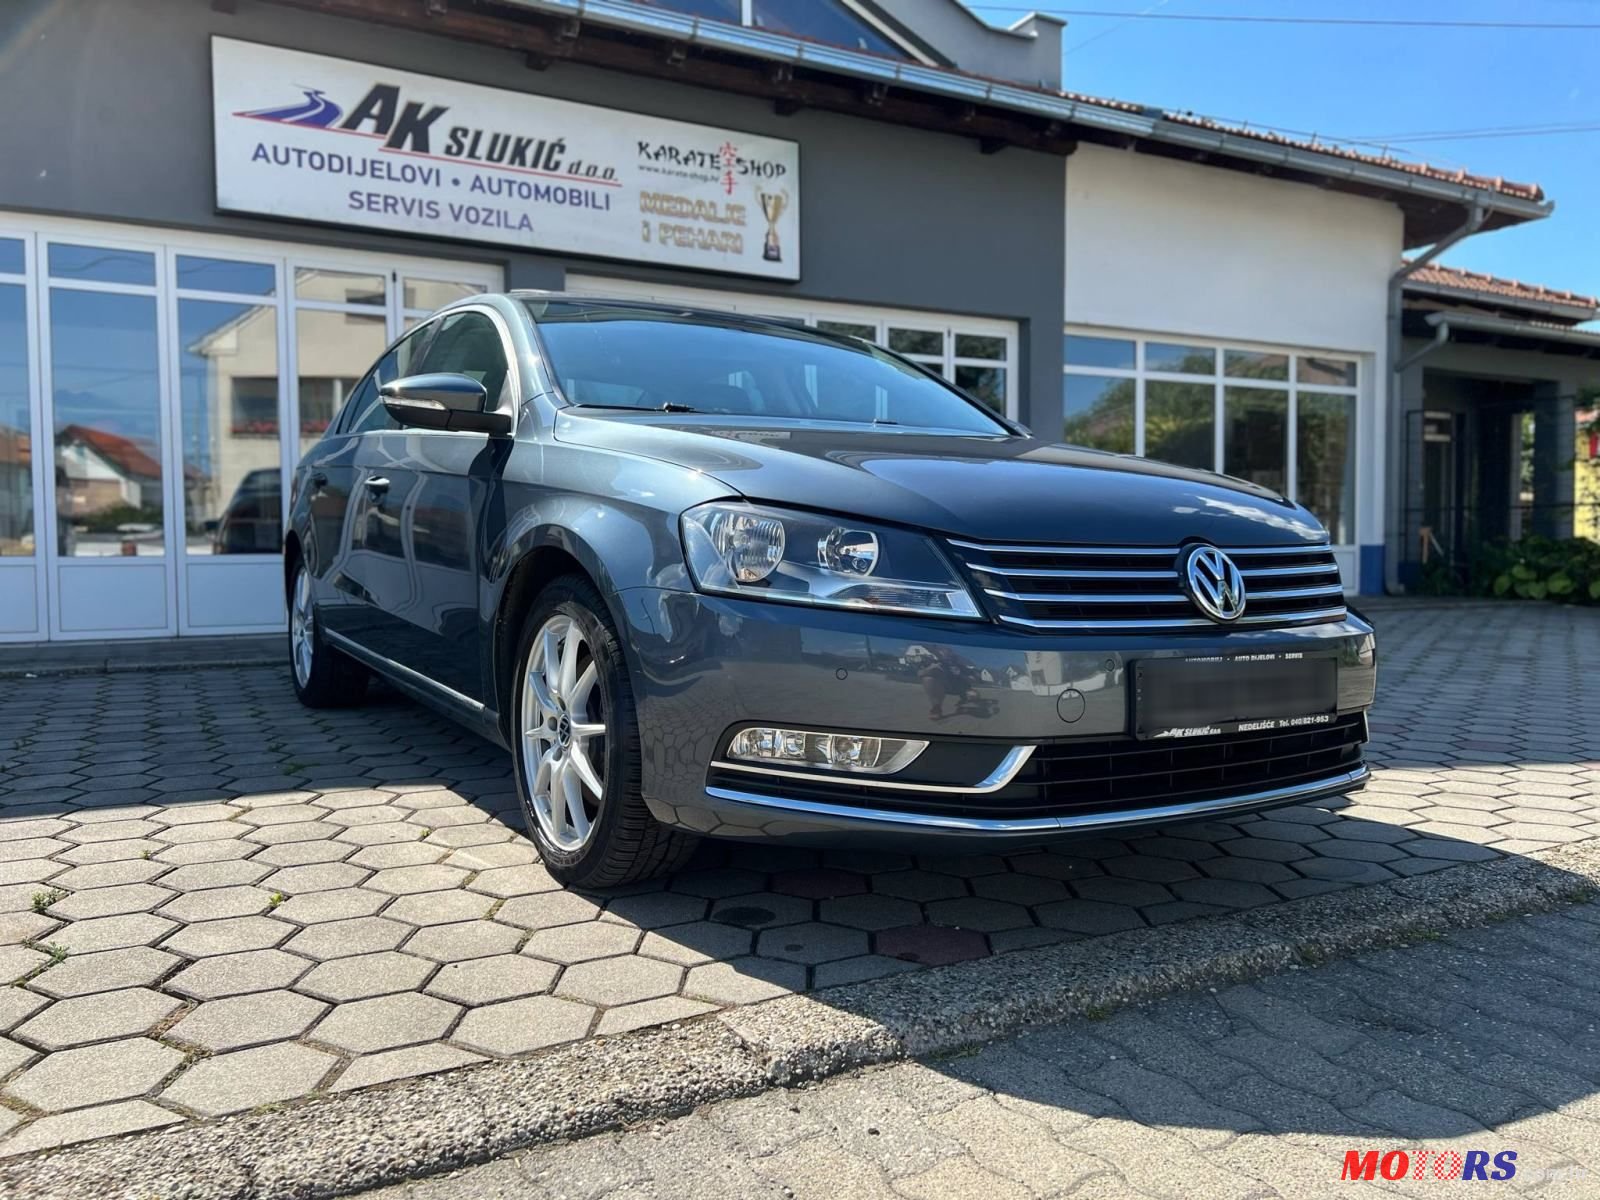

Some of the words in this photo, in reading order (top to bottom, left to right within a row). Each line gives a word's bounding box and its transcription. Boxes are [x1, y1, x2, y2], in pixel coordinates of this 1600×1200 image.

[341, 82, 449, 154] AK
[444, 126, 567, 172] SLUKIĆ
[251, 143, 441, 187] AUTODIJELOVI
[470, 174, 611, 211] AUTOMOBILI
[638, 141, 721, 170] KARATE
[736, 157, 786, 179] SHOP
[348, 190, 440, 219] SERVIS
[449, 203, 534, 232] VOZILA
